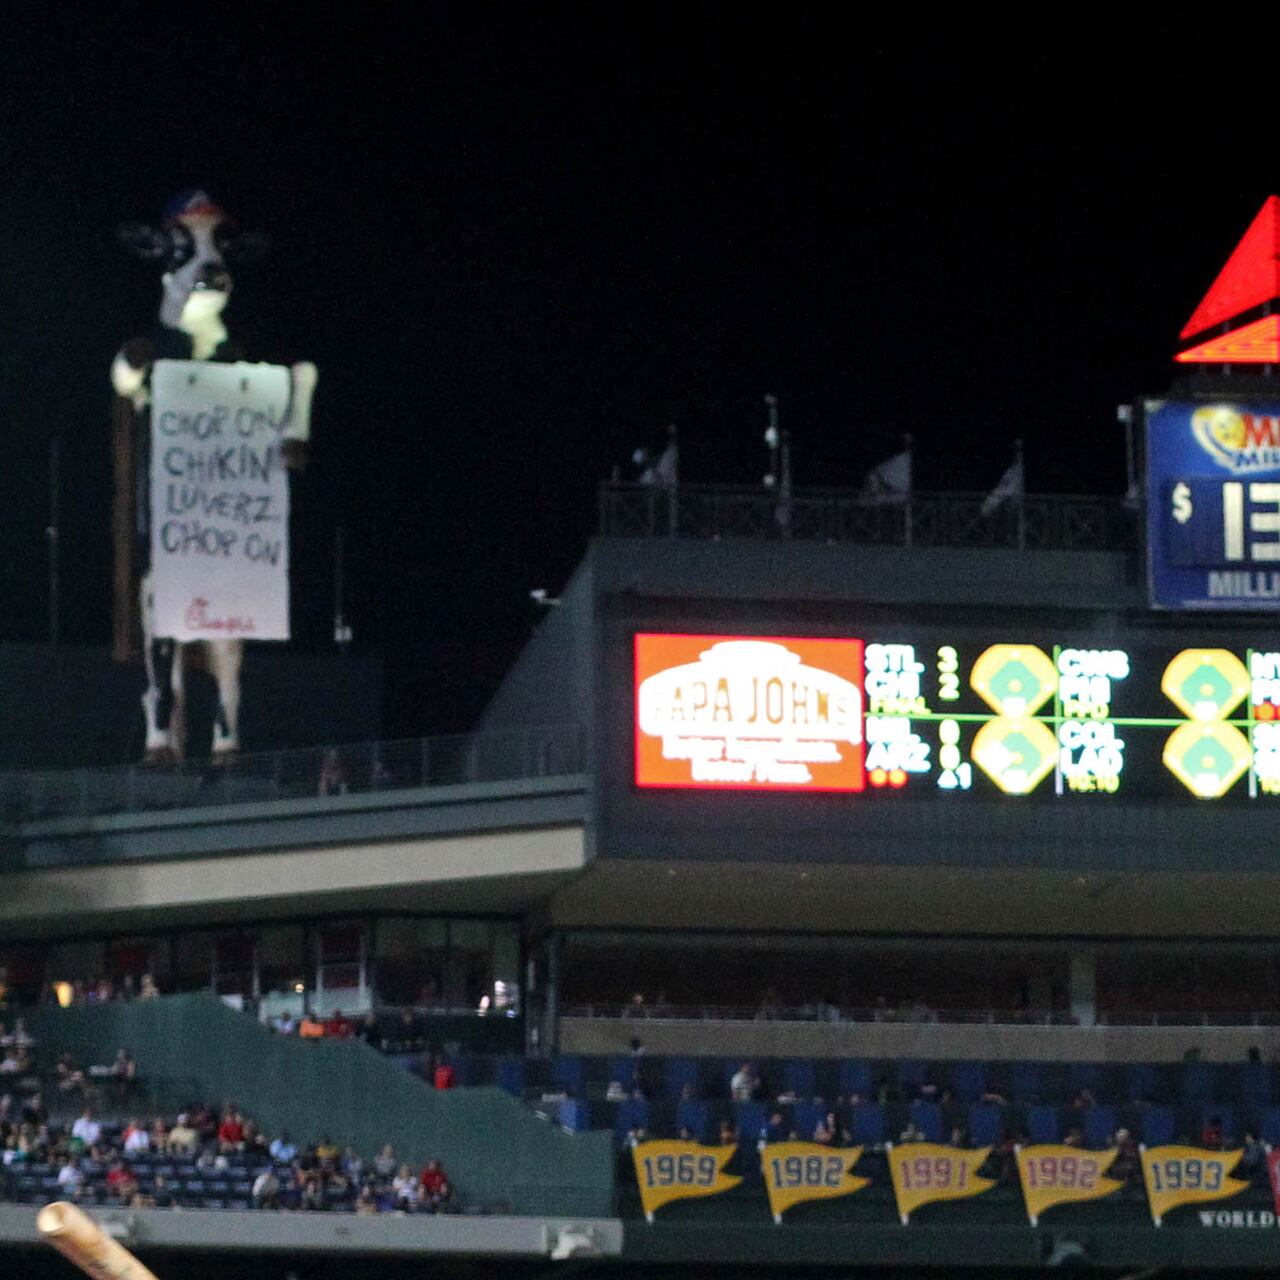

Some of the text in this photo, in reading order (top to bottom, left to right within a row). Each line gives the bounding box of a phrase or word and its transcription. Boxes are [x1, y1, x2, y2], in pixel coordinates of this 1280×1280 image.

[937, 646, 958, 673] 3
[938, 672, 960, 699] 2
[1058, 720, 1125, 749] COL
[643, 1154, 716, 1188] 1969
[771, 1154, 844, 1189] 1982
[901, 1156, 968, 1191] 1991
[1026, 1155, 1099, 1191] 1992
[1151, 1157, 1225, 1193] 1993
[1199, 1210, 1273, 1229] WORLD
